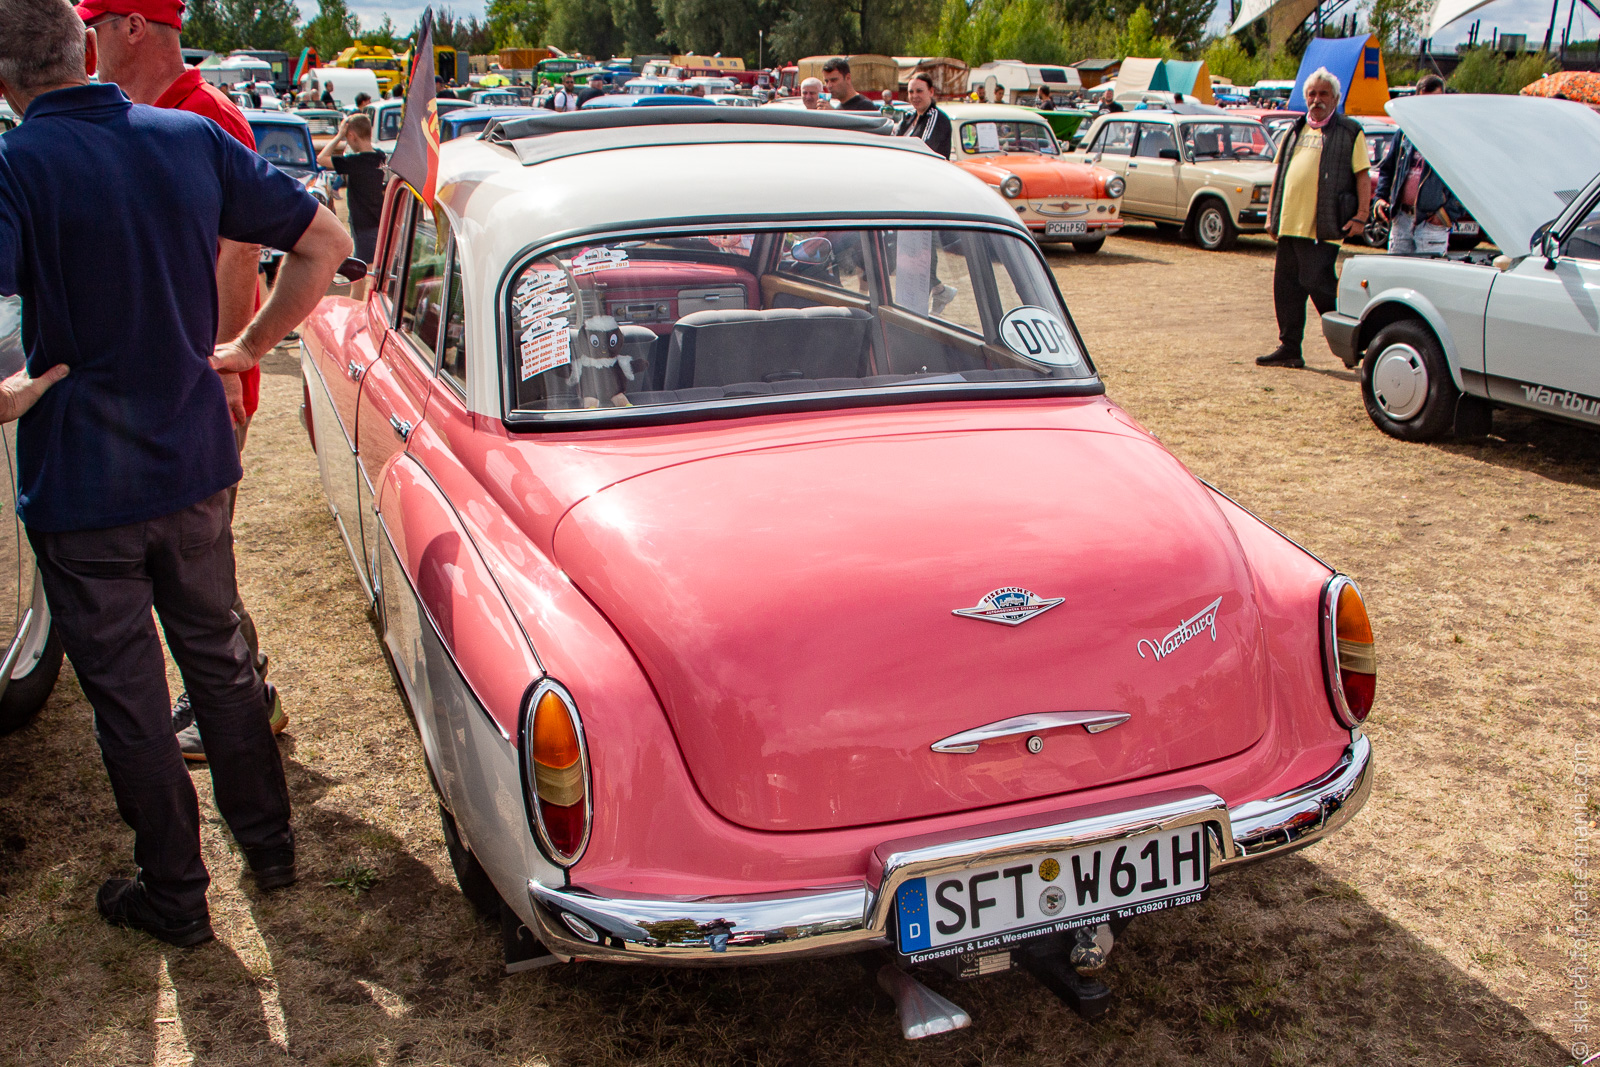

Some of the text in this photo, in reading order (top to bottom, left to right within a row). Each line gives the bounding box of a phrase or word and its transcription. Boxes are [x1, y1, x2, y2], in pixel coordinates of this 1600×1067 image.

[1011, 318, 1076, 355] DDR
[983, 587, 1034, 604] EISENACHER
[1137, 595, 1222, 662] Wartburg
[935, 863, 1034, 936] SFT
[909, 923, 921, 939] D
[910, 946, 964, 963] Karosserie
[966, 942, 975, 951] &
[977, 937, 1001, 949] Lack
[1002, 926, 1053, 943] Wesemann
[1054, 913, 1110, 933] Wolmirstedt
[1117, 910, 1134, 919] Tel.
[1136, 900, 1168, 915] 039201
[1175, 893, 1202, 906] 22878
